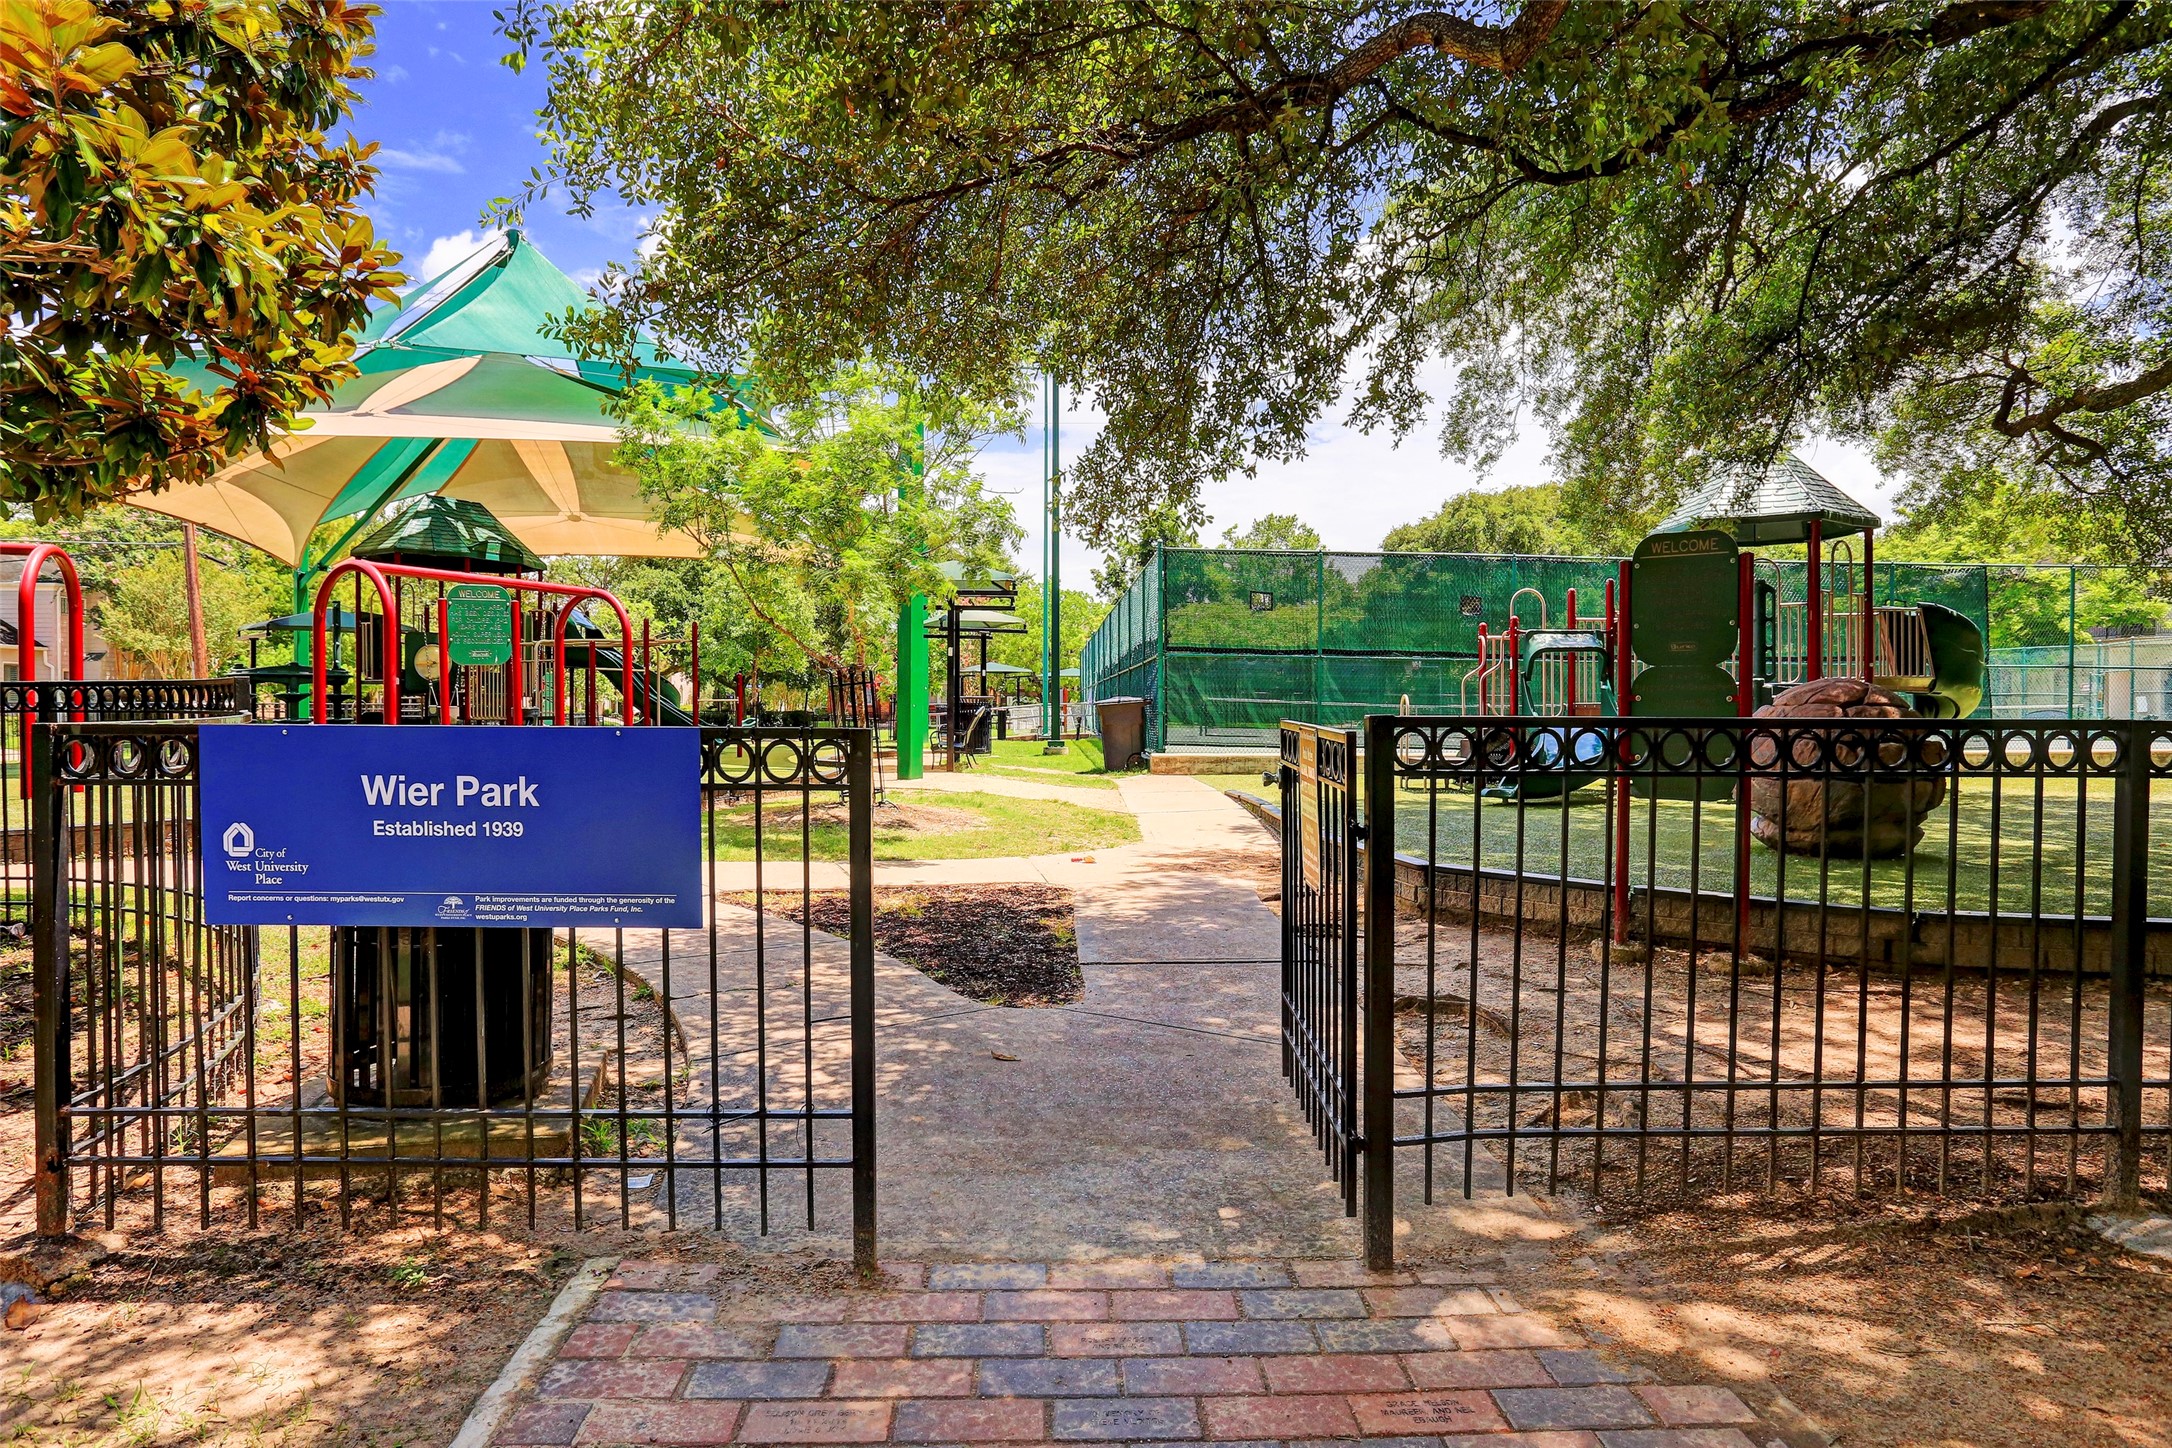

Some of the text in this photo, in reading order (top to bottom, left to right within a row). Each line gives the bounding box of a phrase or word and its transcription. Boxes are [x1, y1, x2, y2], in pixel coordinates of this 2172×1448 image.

[1651, 537, 1719, 554] WELCOME
[458, 589, 500, 599] WELCOME
[360, 774, 540, 808] Wier Park
[373, 820, 524, 838] Established 1939
[255, 847, 288, 861] City of
[226, 860, 309, 875] West University
[255, 873, 283, 885] Place
[228, 894, 252, 903] Report
[294, 895, 329, 903] questions:
[330, 896, 405, 904] myparks@westutx.gov
[475, 895, 491, 903] Park
[492, 896, 540, 904] improvements
[554, 896, 576, 904] funded
[578, 897, 606, 905] through
[619, 897, 654, 905] generosity
[655, 897, 663, 905] of
[664, 897, 675, 905] the
[534, 905, 568, 914] University
[569, 905, 588, 913] Place
[589, 905, 609, 913] Parks
[610, 905, 630, 914] Fund,
[475, 914, 528, 922] westuparks.org
